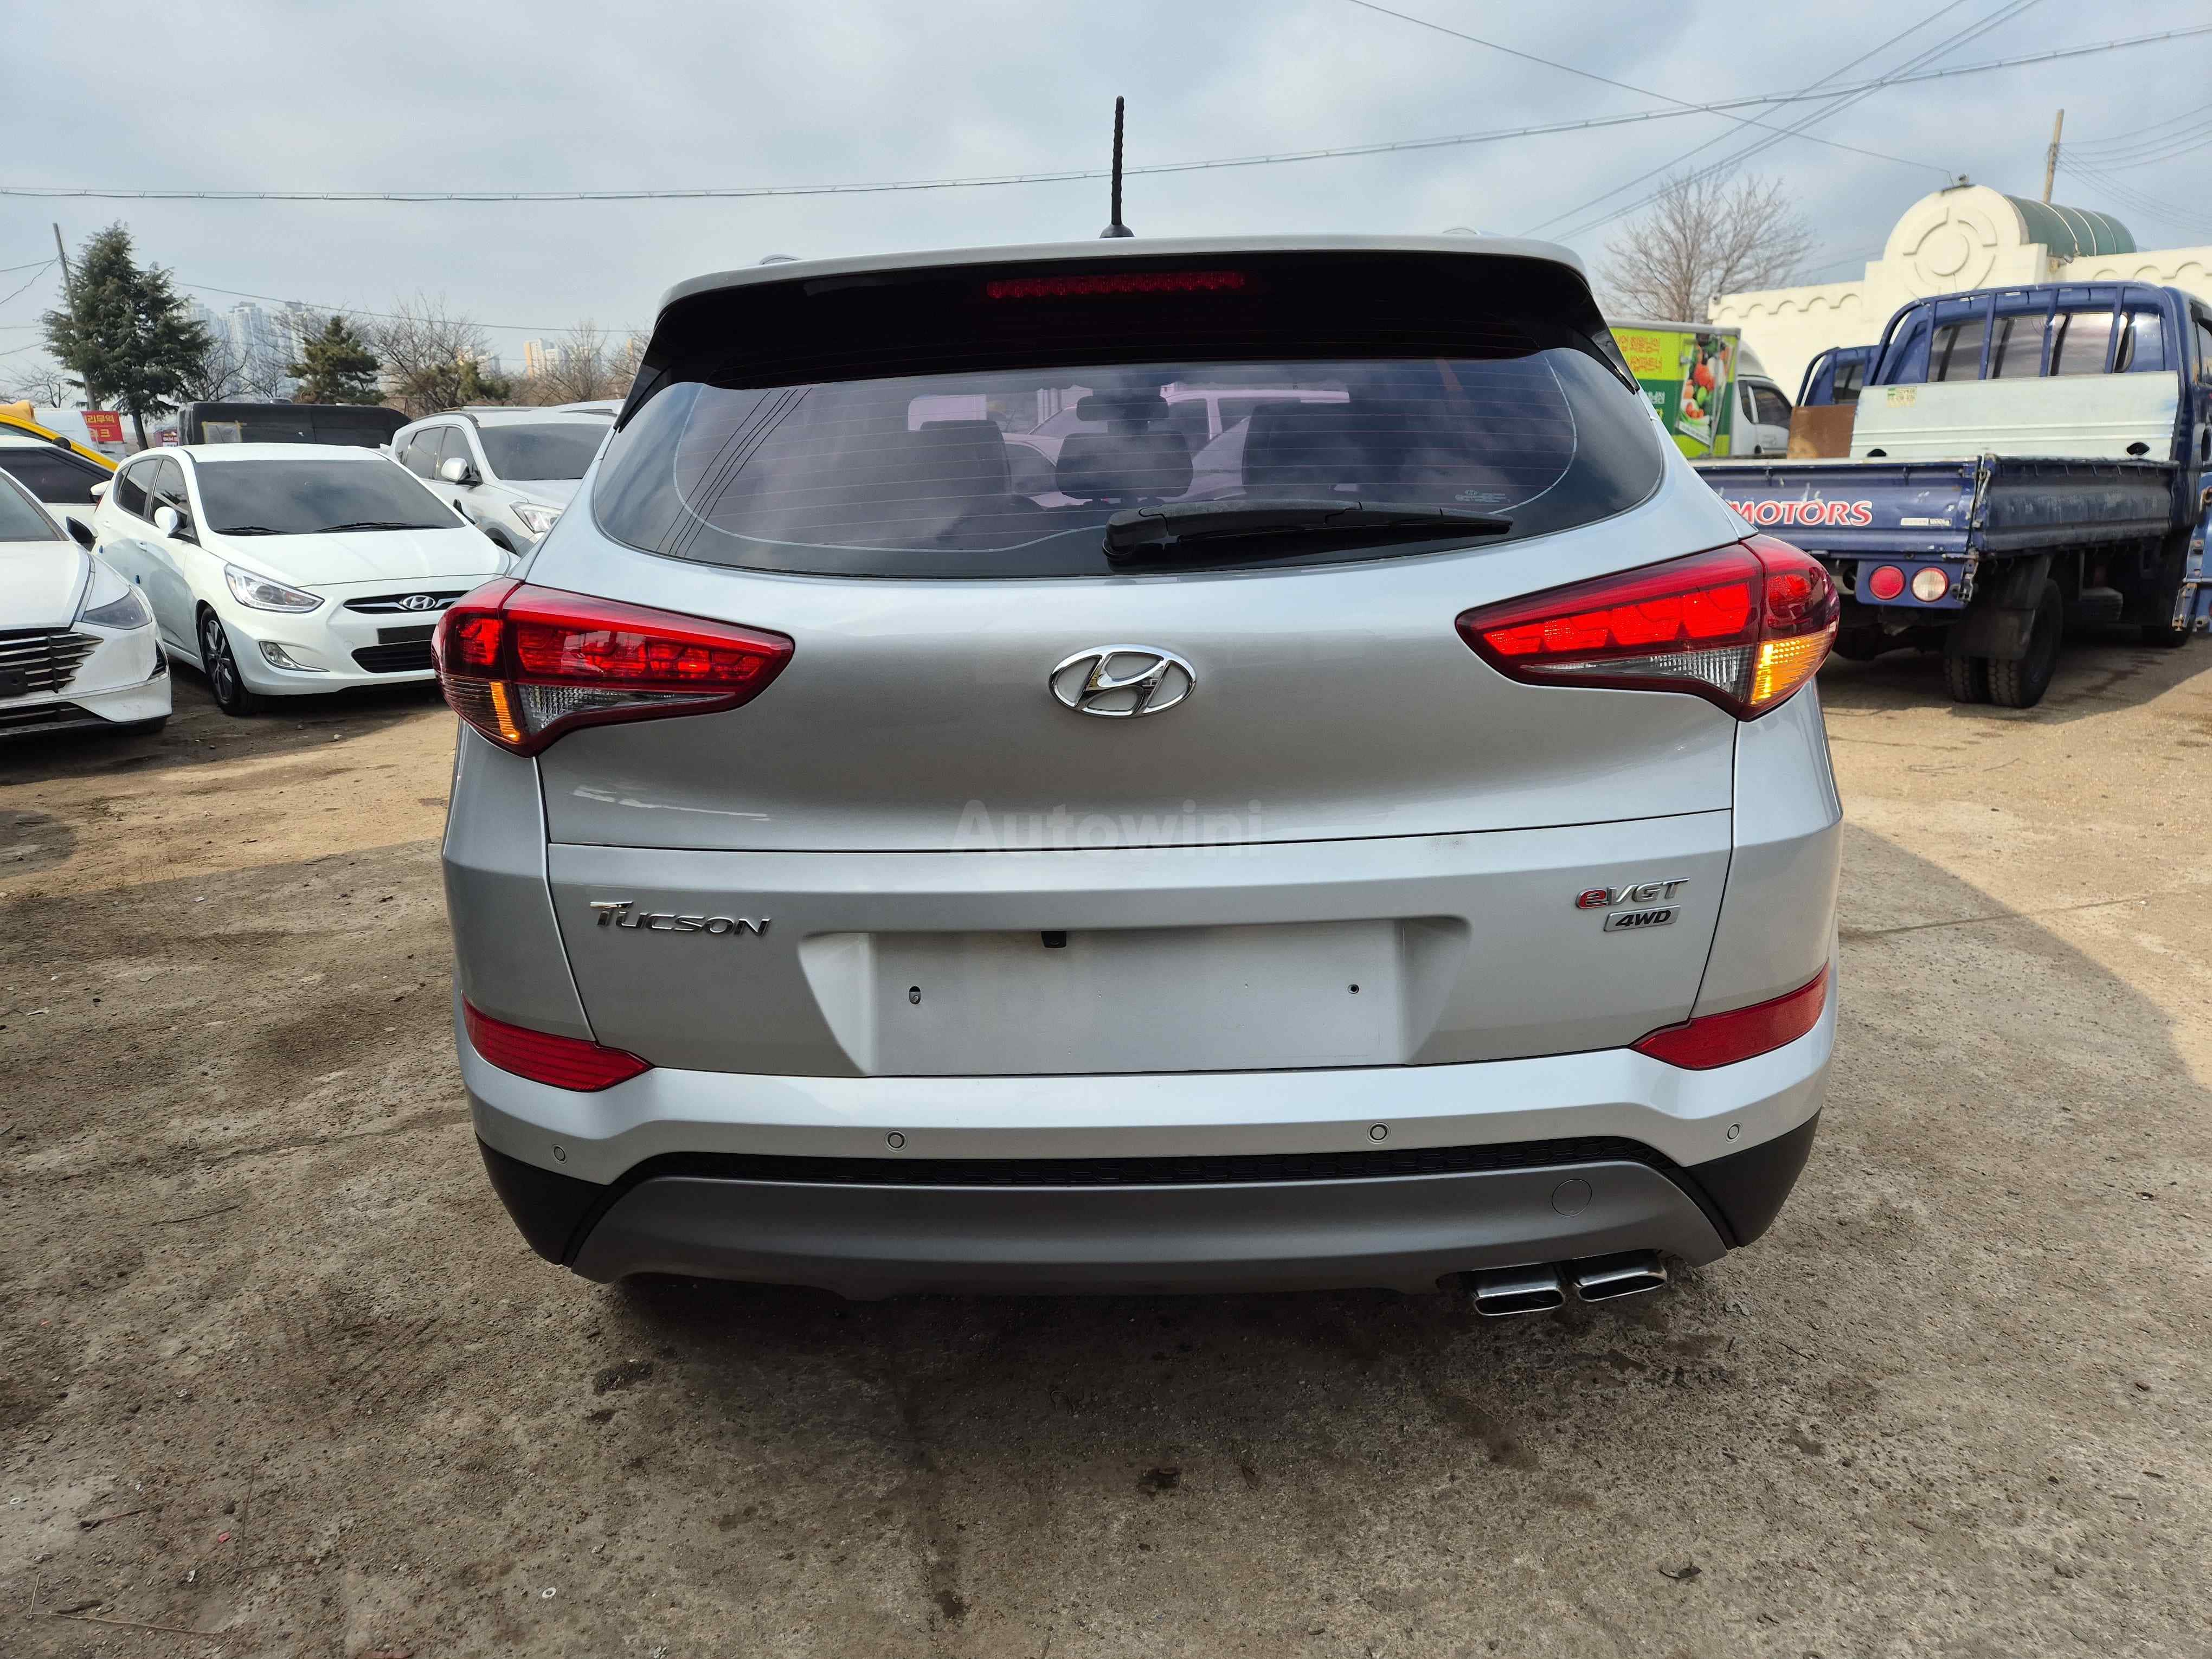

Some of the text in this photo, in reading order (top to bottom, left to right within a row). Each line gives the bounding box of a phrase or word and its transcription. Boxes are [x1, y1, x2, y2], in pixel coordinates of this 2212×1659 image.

[1726, 500, 1873, 526] MOTORS
[1576, 877, 1691, 909] eVGT
[1615, 910, 1671, 927] 4WD
